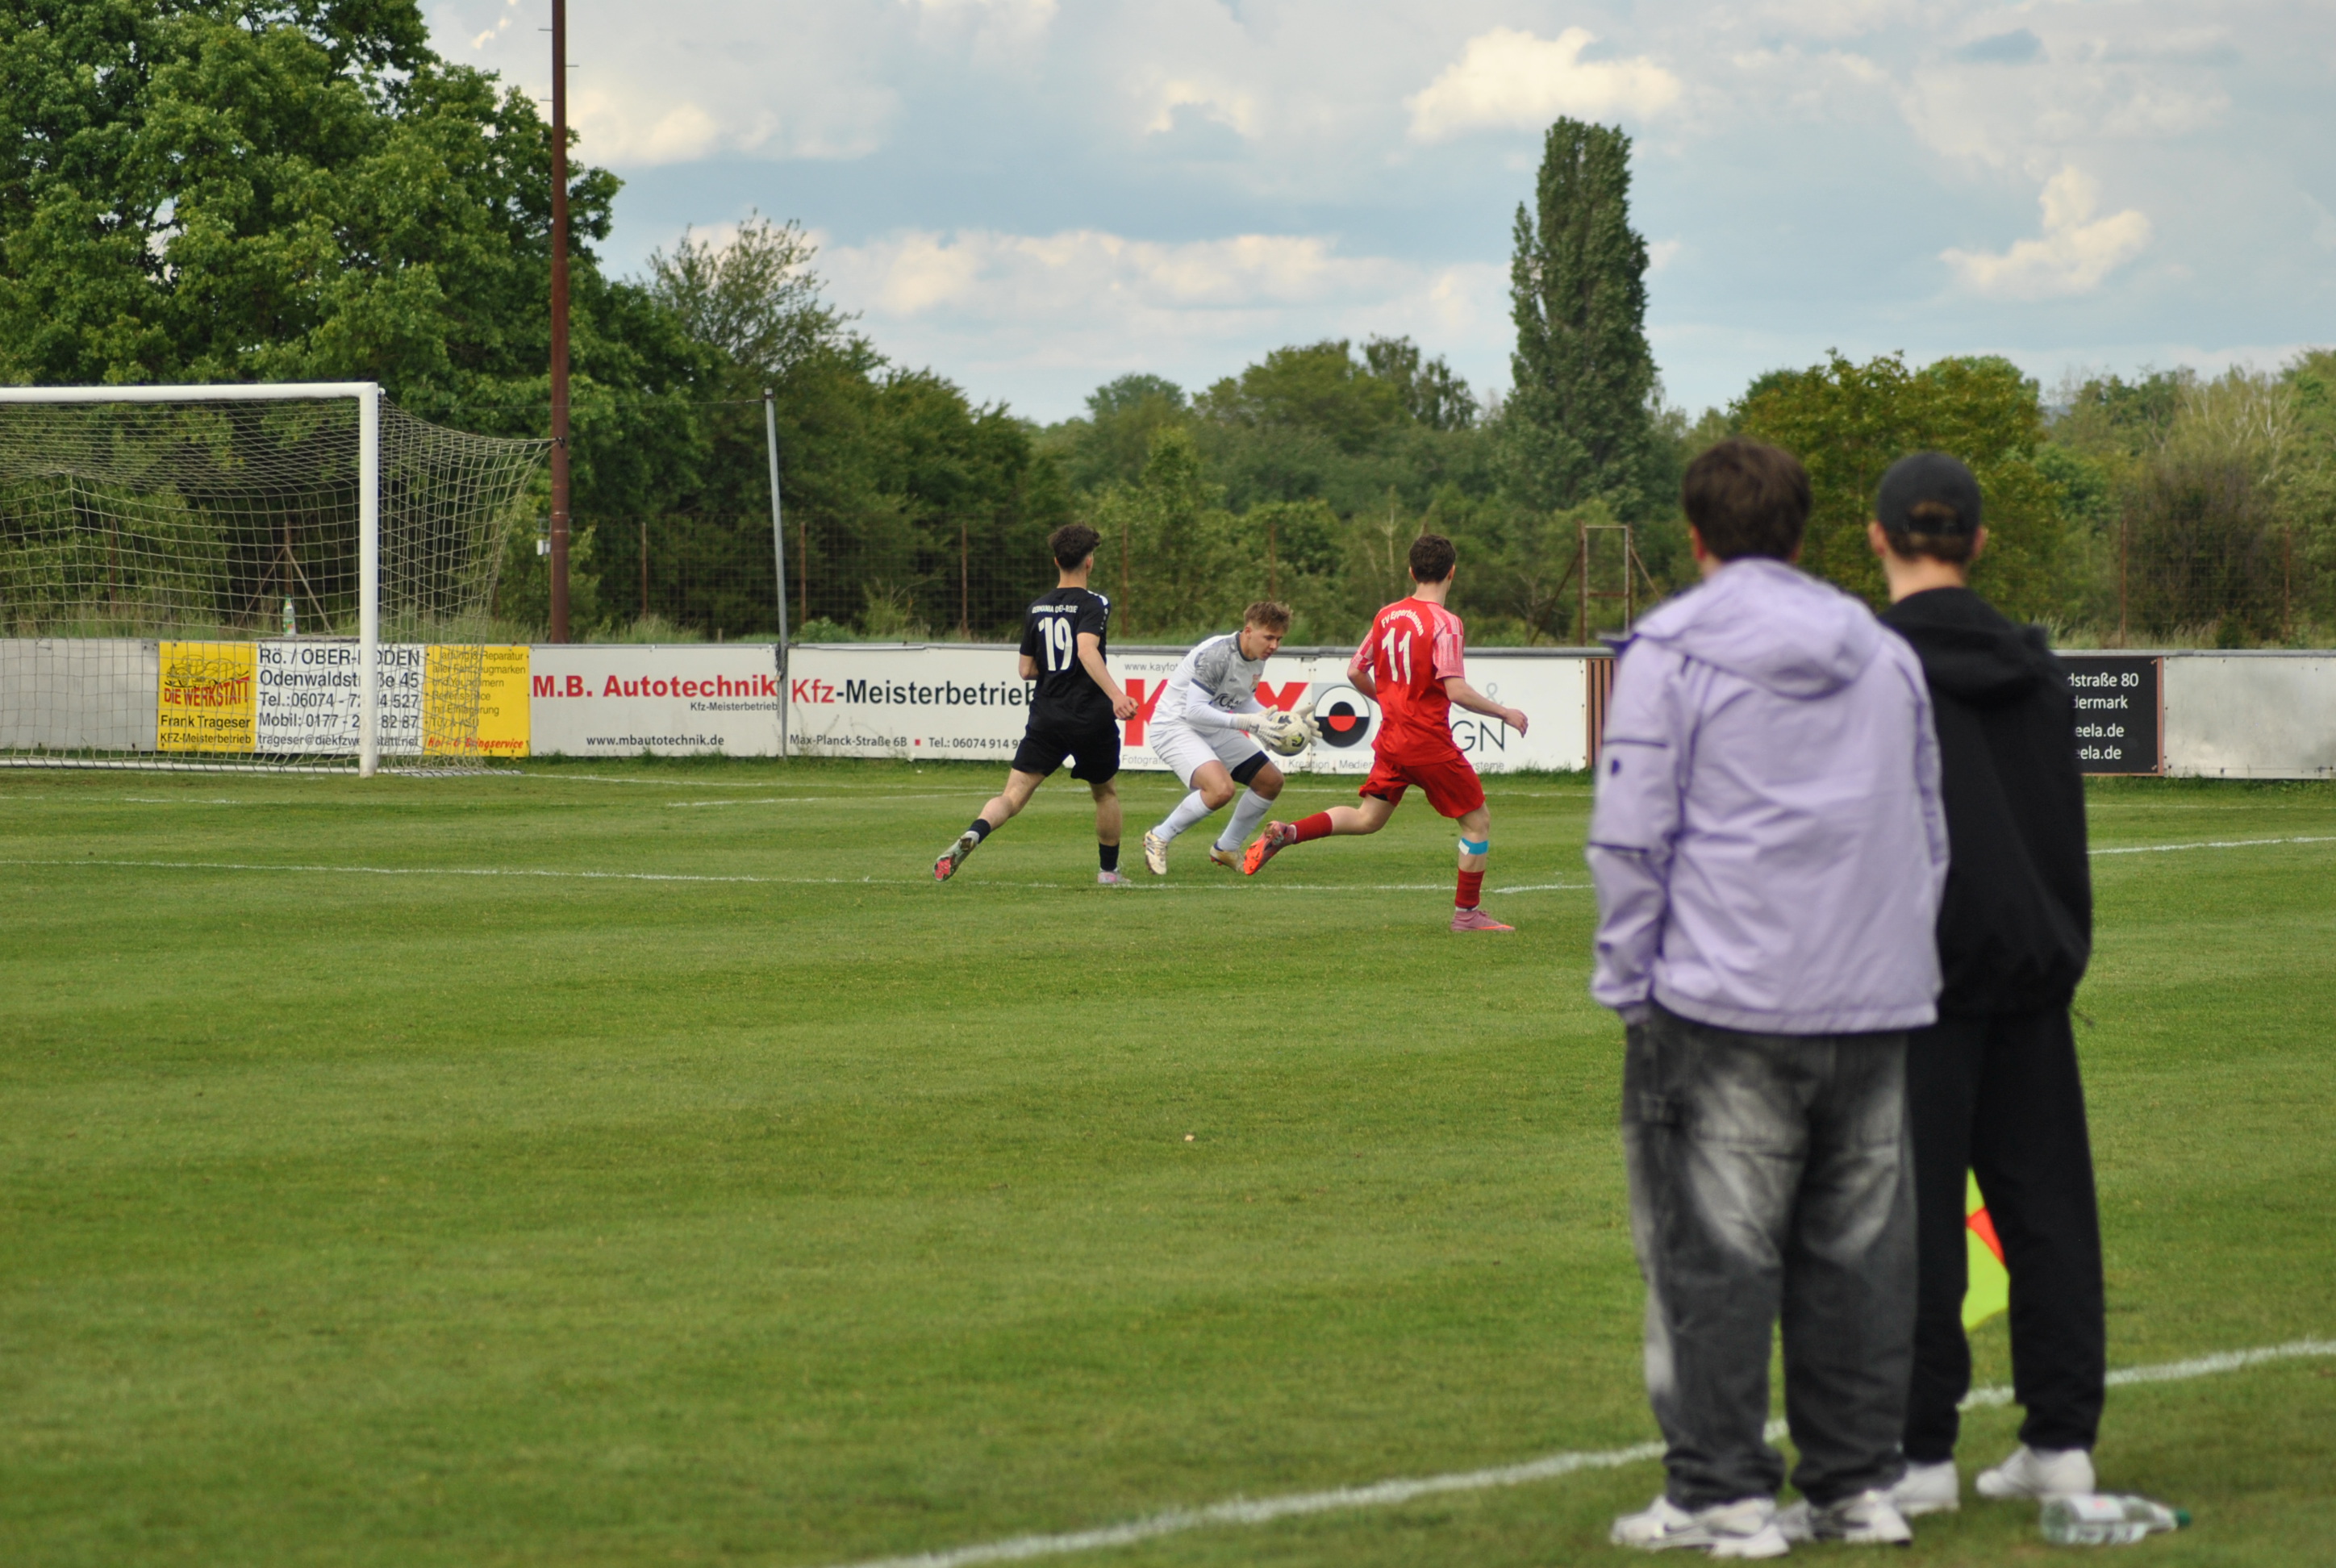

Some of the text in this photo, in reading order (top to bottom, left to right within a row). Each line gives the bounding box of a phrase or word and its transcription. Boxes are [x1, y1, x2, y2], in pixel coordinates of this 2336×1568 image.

[1381, 614, 1390, 628] FV
[1037, 617, 1072, 670] 19
[259, 648, 286, 664] Rö.
[301, 648, 419, 665] OBER-DEN
[1381, 627, 1411, 684] 11
[259, 669, 419, 688] Odenwaldstße 45
[532, 674, 778, 698] M.B. Autotechnik
[2121, 672, 2139, 686] 80
[164, 676, 249, 707] DIE WERKSTATT
[791, 678, 1035, 706] Kfz-Meisterbetrieb
[392, 694, 419, 708] 527
[690, 701, 778, 711] Kfz-Meisterbetrieb
[161, 715, 251, 731] Frank Trageser
[258, 712, 301, 727] Mobil:
[306, 713, 338, 728] 0177
[381, 714, 397, 728] 82
[402, 715, 419, 728] 87
[160, 732, 251, 744] KFZ-Meisterbetrieb
[586, 733, 724, 746] www.mbautotechnik.de
[790, 734, 891, 747] Max-Planck-Straße
[928, 736, 949, 748] Tel.:
[953, 737, 986, 748] 06074
[989, 738, 1008, 749] 914
